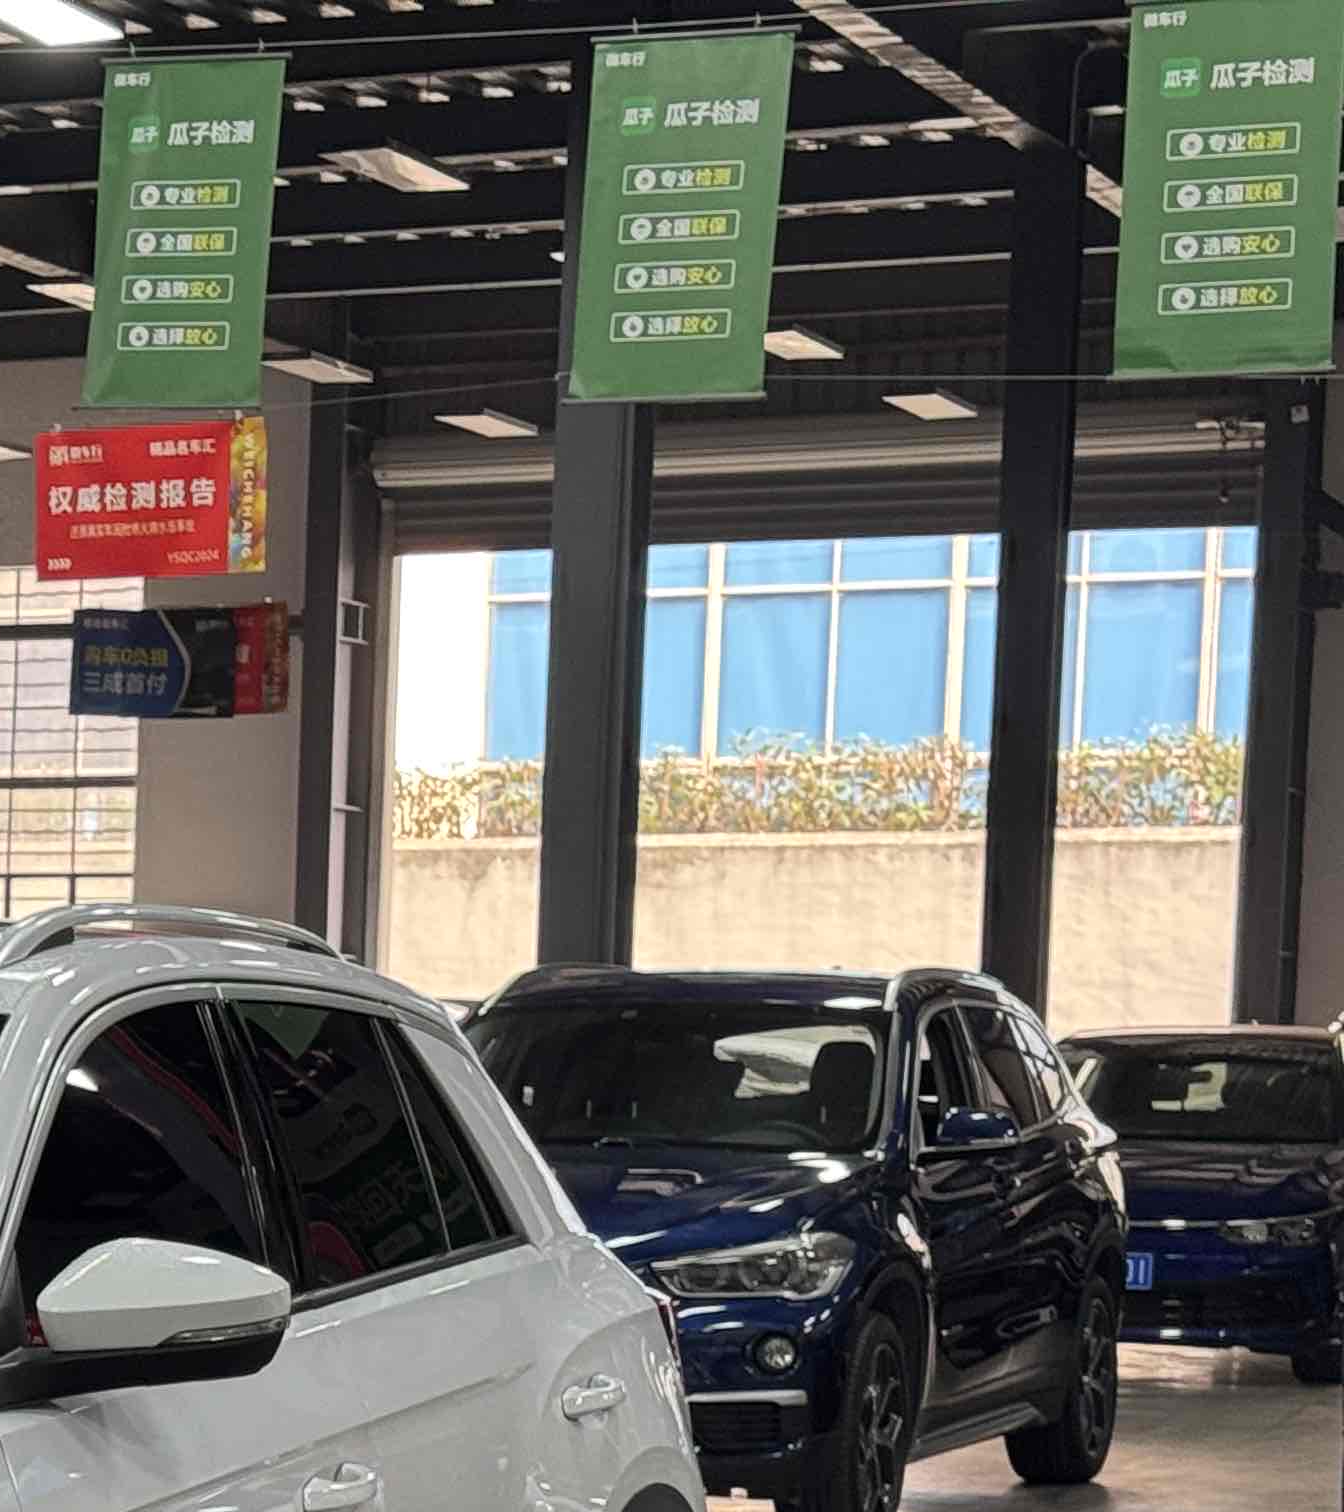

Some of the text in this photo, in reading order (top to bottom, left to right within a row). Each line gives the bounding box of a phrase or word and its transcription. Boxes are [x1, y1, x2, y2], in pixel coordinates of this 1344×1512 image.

[1164, 69, 1198, 88] 瓜子
[1210, 57, 1315, 89] 瓜子检测
[622, 107, 654, 126] 瓜子
[664, 98, 760, 128] 瓜子检测
[167, 119, 255, 146] 瓜子检测
[1209, 130, 1288, 152] 专业检测
[662, 168, 732, 188] 专业检测
[164, 185, 230, 205] 专业检测
[1205, 182, 1284, 205] 全国联保
[48, 478, 216, 514] 权威检测报告
